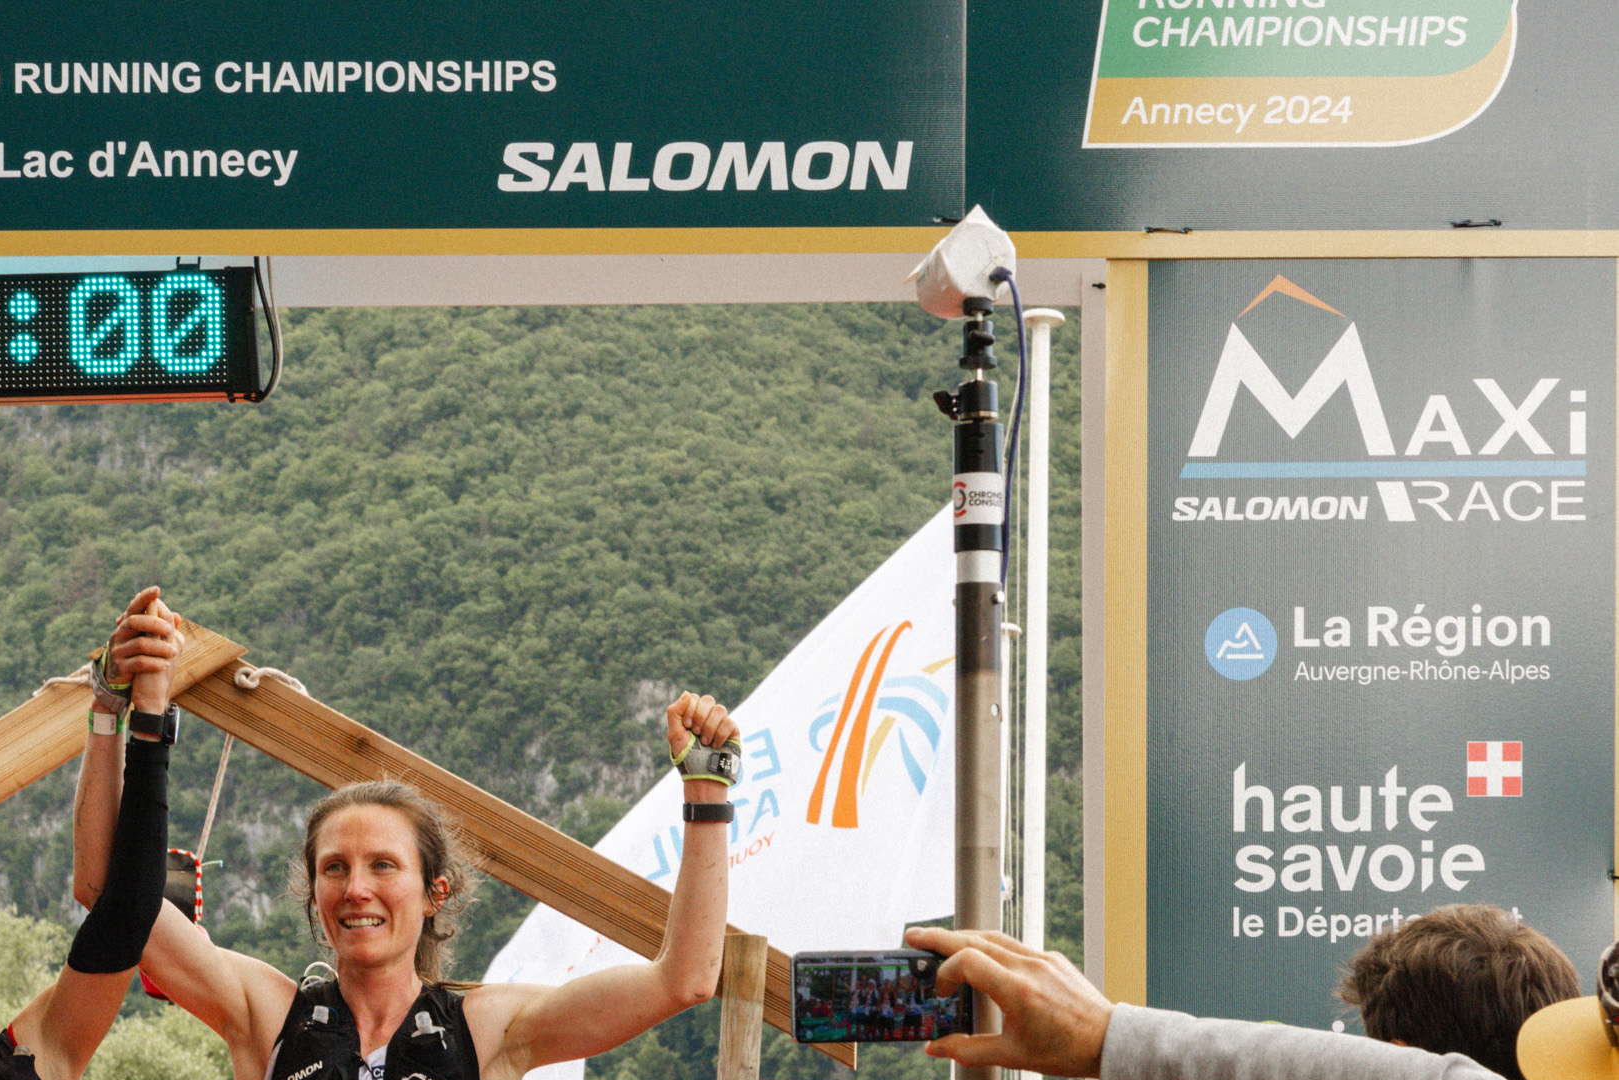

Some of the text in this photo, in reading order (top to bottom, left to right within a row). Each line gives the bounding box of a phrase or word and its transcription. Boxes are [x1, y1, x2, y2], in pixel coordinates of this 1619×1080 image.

[1132, 16, 1469, 47] CHAMPIONSHIPS
[14, 61, 202, 95] RUNNING
[214, 60, 558, 93] CHAMPIONSHIPS
[1120, 95, 1353, 134] Annecy 2024
[87, 140, 299, 187] d'Annecy
[497, 141, 914, 192] SALOMON
[1172, 481, 1587, 522] SALOMON RACE
[1293, 603, 1552, 657] La Région
[1293, 659, 1551, 685] Auvergne-Rhône-Alpes
[1232, 761, 1455, 834] haute
[1233, 840, 1487, 894] savoie
[1232, 906, 1264, 938] le
